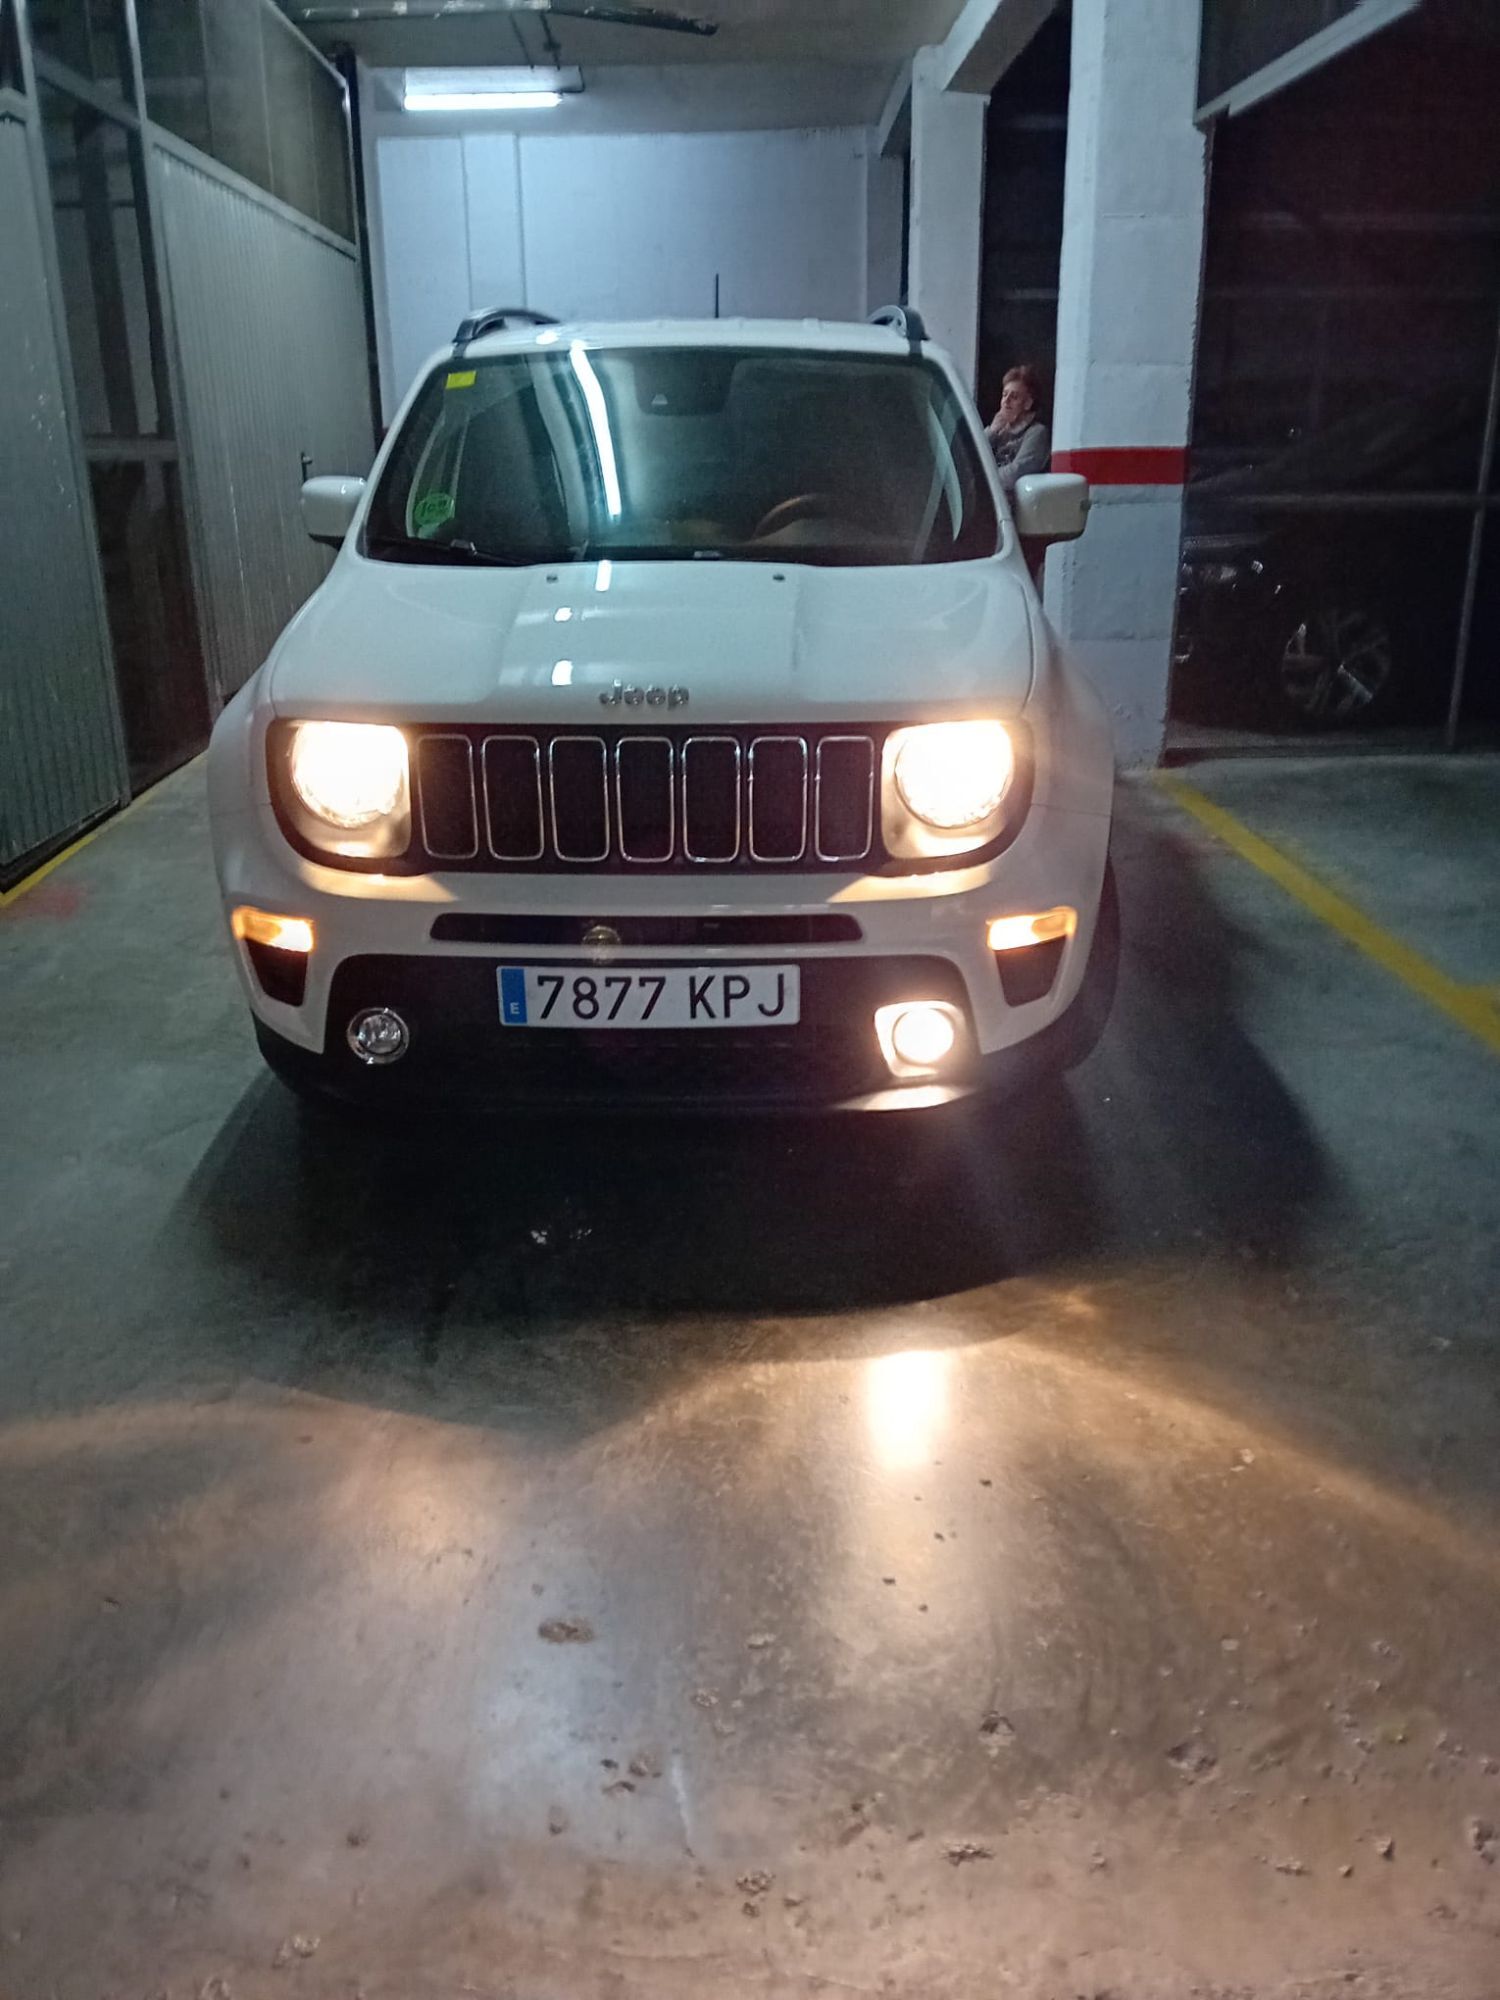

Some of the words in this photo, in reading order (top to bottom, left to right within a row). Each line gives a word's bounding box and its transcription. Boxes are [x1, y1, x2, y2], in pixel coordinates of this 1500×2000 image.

[599, 680, 690, 710] Jeep
[509, 1001, 520, 1014] E
[537, 974, 666, 1020] 7877
[688, 973, 785, 1019] KPJ
